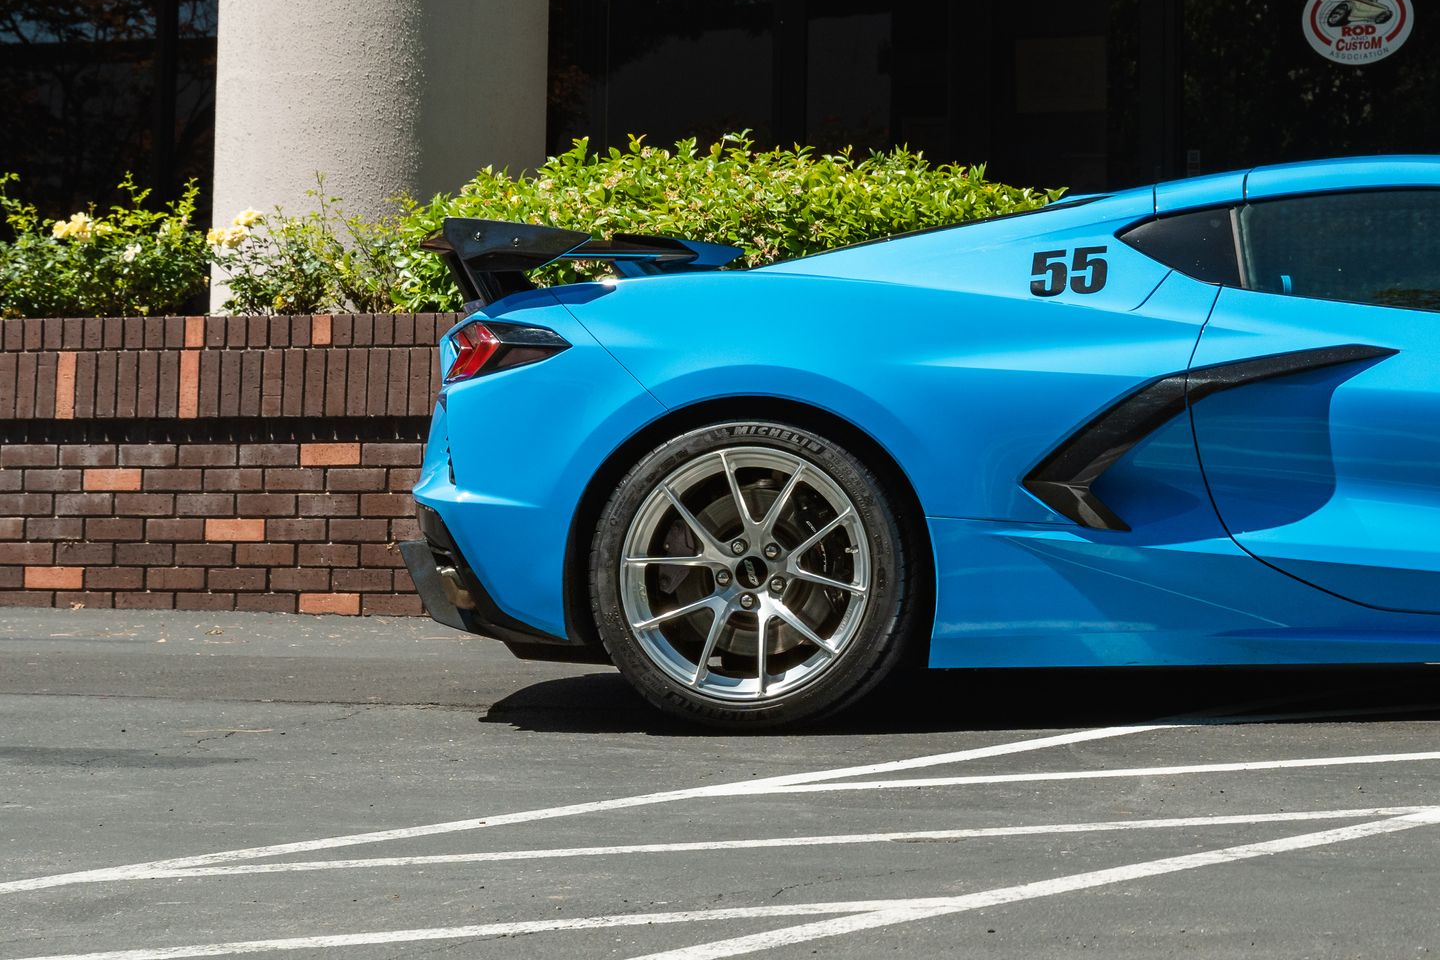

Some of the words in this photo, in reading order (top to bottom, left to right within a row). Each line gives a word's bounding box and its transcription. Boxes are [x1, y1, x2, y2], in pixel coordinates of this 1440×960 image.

[1342, 25, 1376, 37] ROD
[1329, 47, 1389, 60] ASSOCIATION
[1030, 246, 1107, 297] 55
[733, 426, 822, 453] MICHELIN
